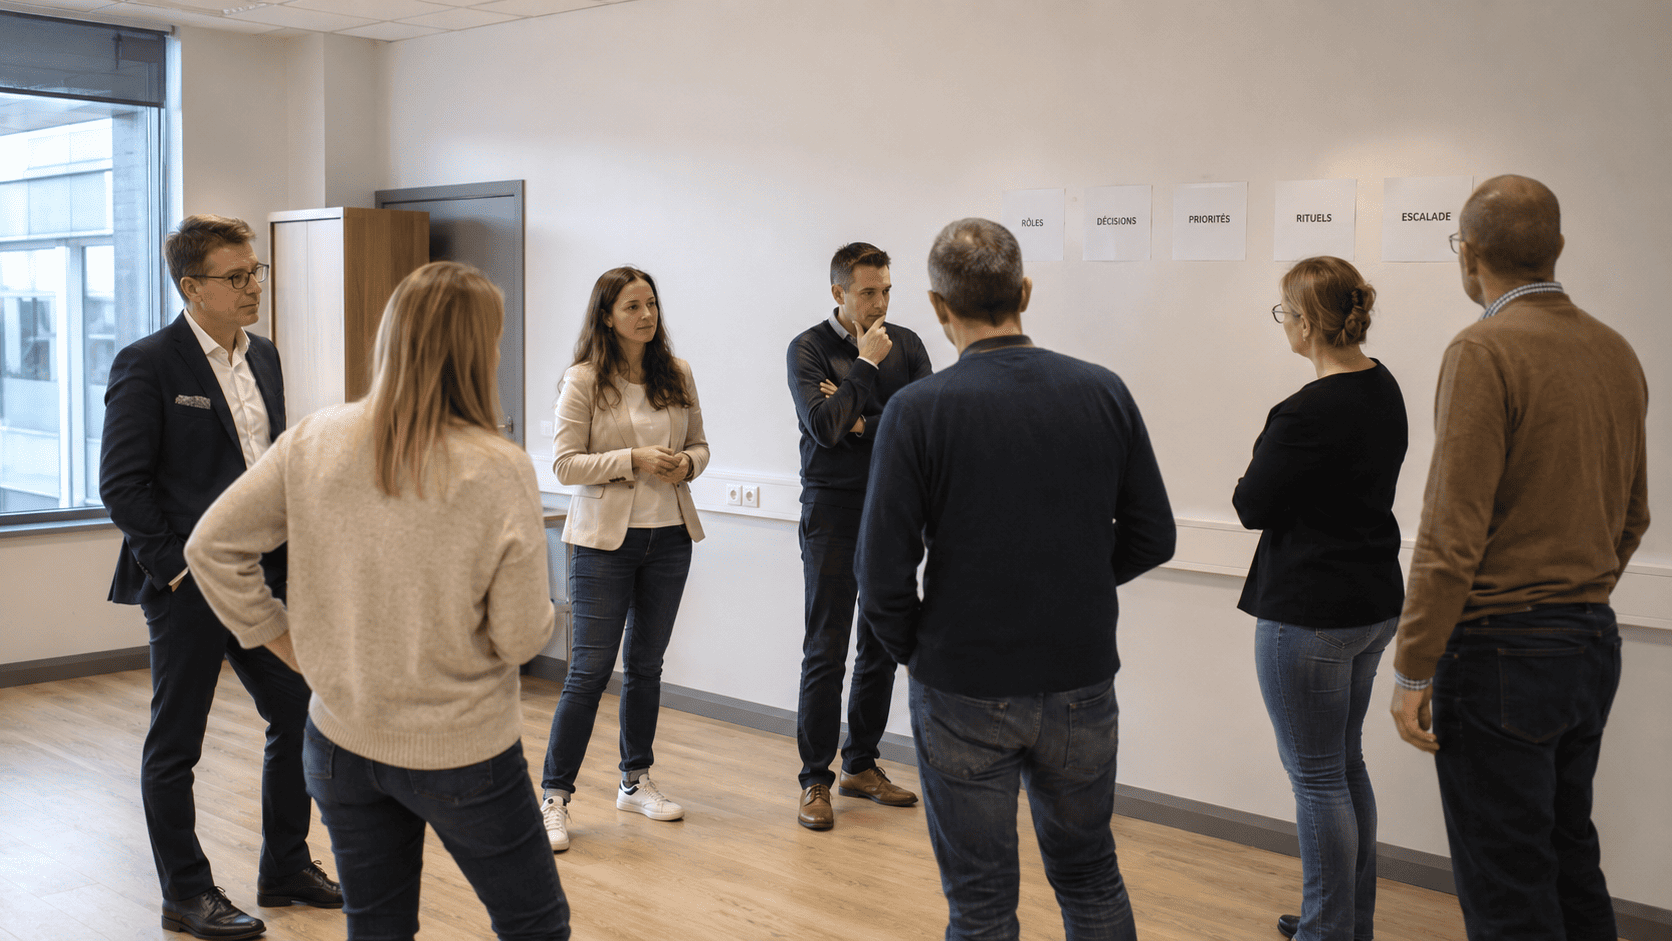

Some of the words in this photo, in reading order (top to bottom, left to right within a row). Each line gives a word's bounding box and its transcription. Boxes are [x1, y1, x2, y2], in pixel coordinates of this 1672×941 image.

[1096, 215, 1137, 226] DÉCISIONS
[1188, 213, 1231, 224] PRIORITÉS
[1296, 213, 1332, 223] RITUELS
[1401, 211, 1452, 222] ESCALADE
